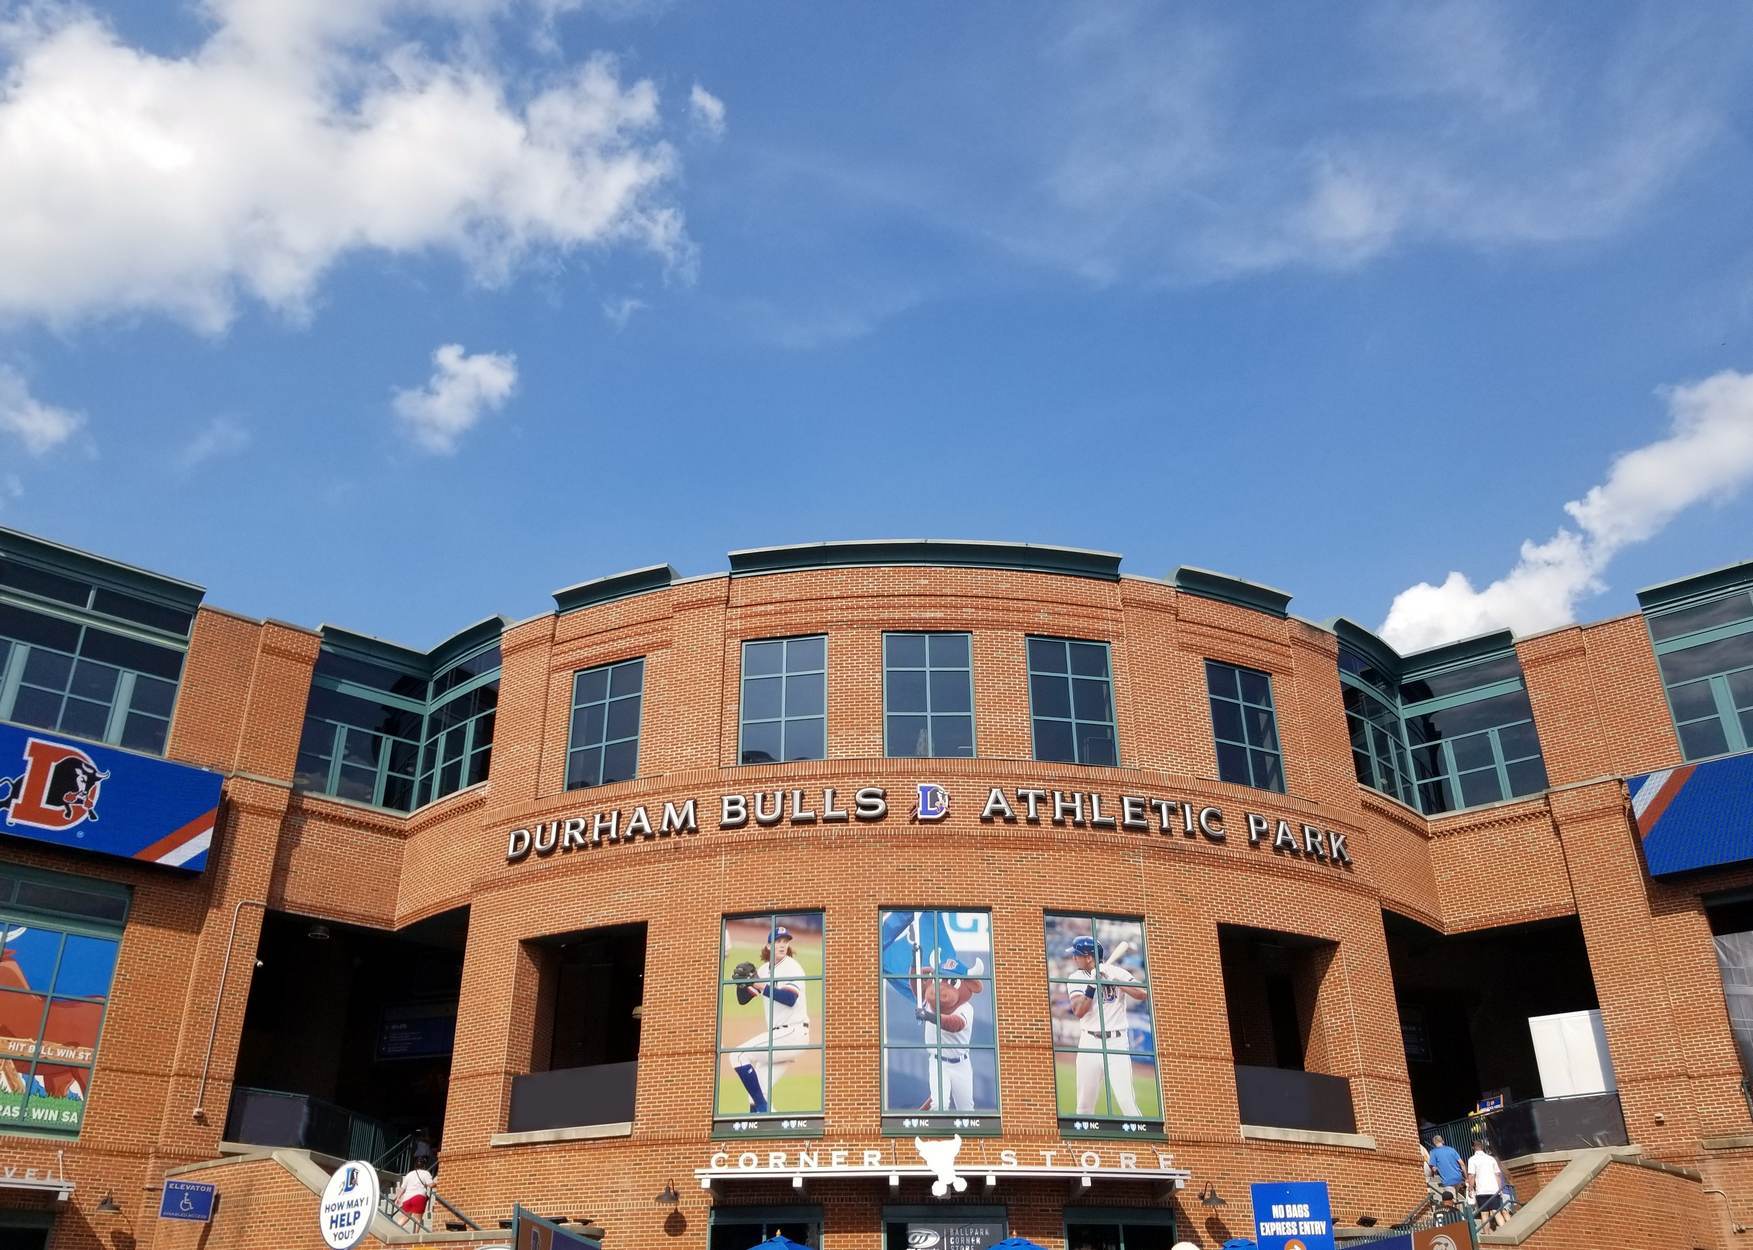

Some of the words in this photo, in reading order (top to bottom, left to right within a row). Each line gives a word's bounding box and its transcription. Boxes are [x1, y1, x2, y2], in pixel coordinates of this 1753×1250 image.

[506, 799, 698, 862] DURHAM
[720, 787, 889, 827] BULLS
[980, 787, 1227, 840] ATHLETIC
[1246, 811, 1353, 865] PARK
[8, 1041, 26, 1053] HIT
[28, 1045, 54, 1056] BLL
[57, 1048, 76, 1059] WIN
[32, 1108, 59, 1121] WIN
[748, 1121, 758, 1129] NC
[797, 1119, 807, 1128] NC
[919, 1119, 929, 1127] NC
[970, 1119, 980, 1127] NC
[1090, 1122, 1099, 1130] NC
[1137, 1123, 1147, 1131] NC
[710, 1150, 882, 1169] CORNER
[1000, 1150, 1174, 1169] STORE
[169, 1183, 212, 1192] ELEVATOR
[325, 1201, 345, 1213] HOW
[346, 1197, 365, 1209] MAY
[1272, 1204, 1285, 1218] NO
[1285, 1204, 1310, 1218] BAGS
[329, 1210, 361, 1230] HELP
[949, 1228, 990, 1236] BALLPARK
[1260, 1221, 1298, 1236] EXPRESS
[1298, 1220, 1327, 1235] ENTRY
[333, 1229, 355, 1242] YOU?
[949, 1236, 981, 1245] CORNER
